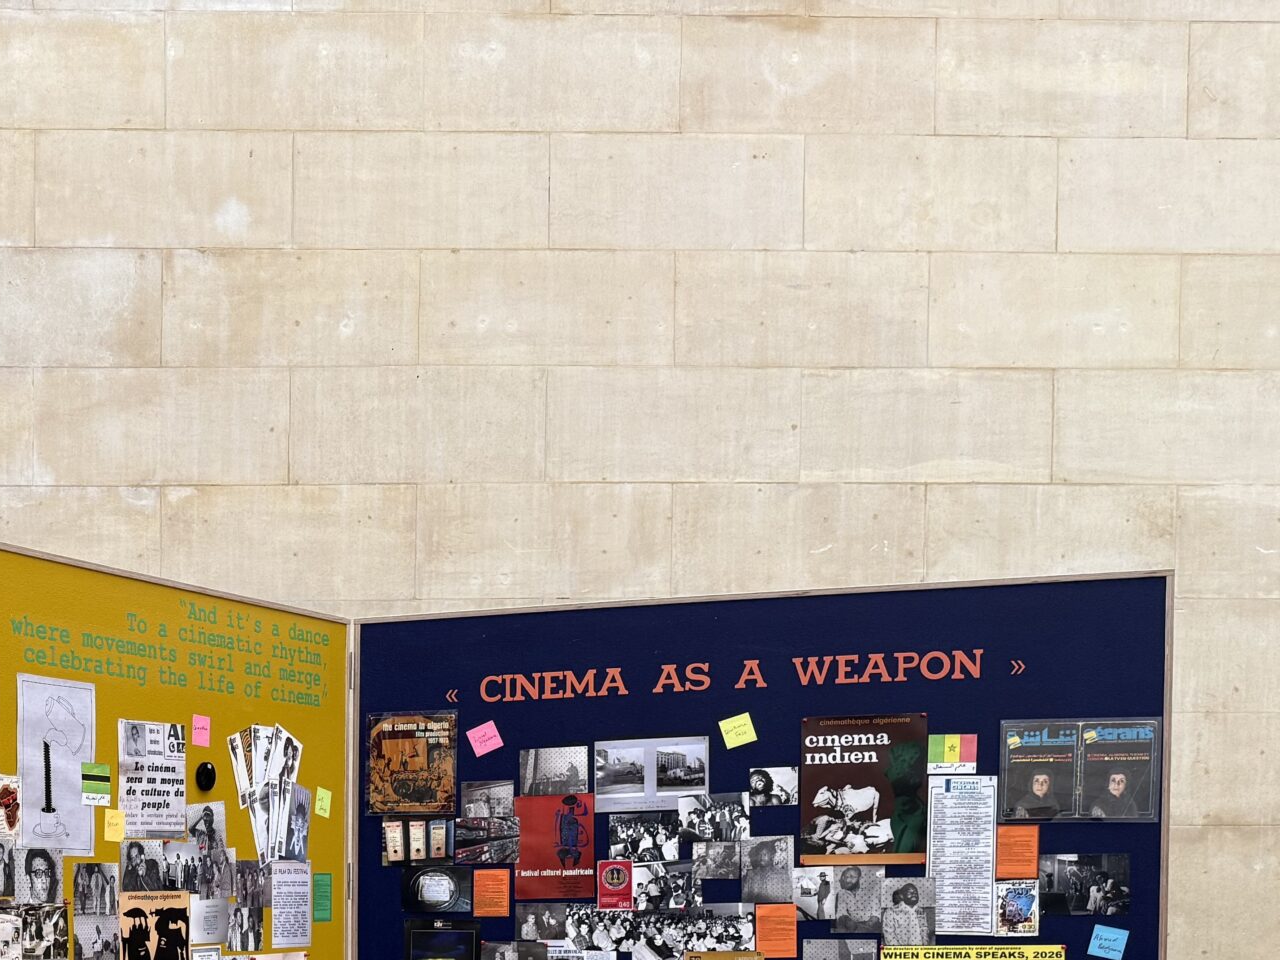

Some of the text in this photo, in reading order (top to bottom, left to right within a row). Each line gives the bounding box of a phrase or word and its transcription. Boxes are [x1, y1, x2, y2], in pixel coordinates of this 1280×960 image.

[126, 612, 148, 635] To
[158, 622, 168, 637] a
[178, 625, 263, 656] cinematic
[227, 611, 262, 634] it's
[272, 624, 280, 637] a
[288, 622, 330, 647] dance
[10, 615, 71, 644] where
[81, 631, 178, 663] movements
[188, 649, 235, 673] swirl
[244, 660, 272, 678] and
[23, 646, 148, 688] celebrating
[158, 665, 188, 688] the
[198, 671, 235, 695] life
[244, 681, 263, 698] of
[479, 667, 629, 704] CINEMA
[652, 662, 712, 694] AS
[734, 659, 767, 689] A
[792, 649, 985, 686] WEAPON
[394, 722, 417, 731] cinema
[804, 732, 891, 748] cinema
[804, 747, 879, 765] indien
[134, 761, 176, 773] Le cinéma
[126, 775, 184, 789] sera un moyen
[125, 786, 185, 798] de culture du
[141, 799, 171, 811] peuple
[882, 951, 1063, 960] WHEN CINEMA SPEAKS, 2026
